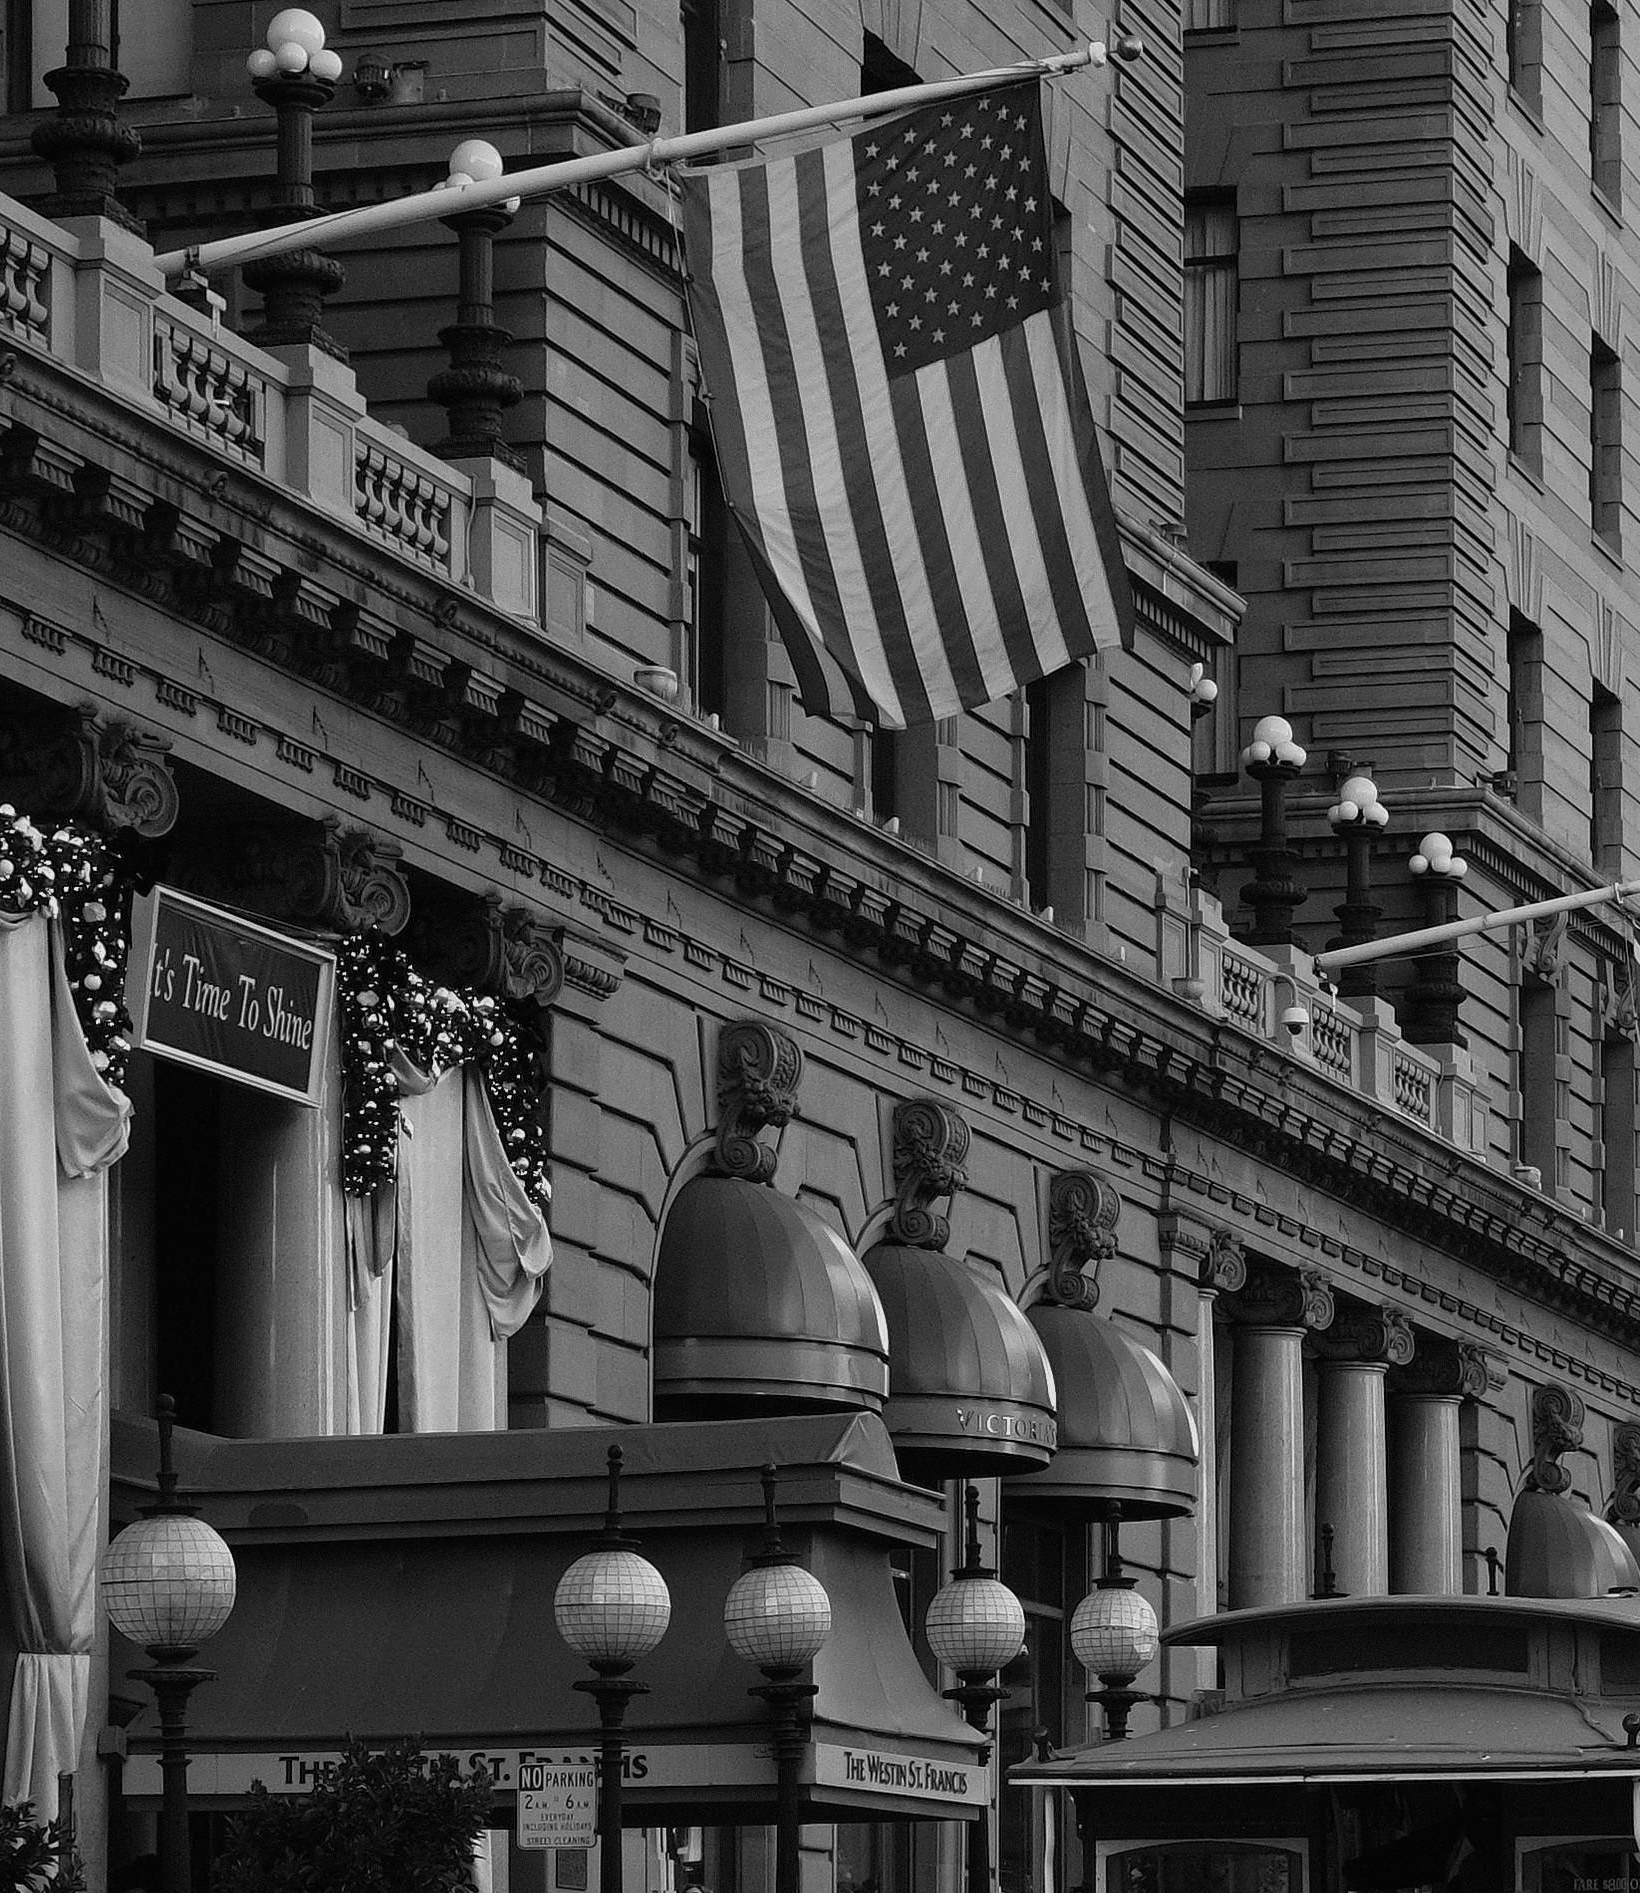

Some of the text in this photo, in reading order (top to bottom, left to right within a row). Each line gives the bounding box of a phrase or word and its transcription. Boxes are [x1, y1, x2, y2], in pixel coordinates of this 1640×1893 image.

[154, 948, 312, 1050] t's Time To Shine
[521, 1766, 542, 1789] NO
[545, 1771, 594, 1788] PARKING
[844, 1751, 865, 1781] THE
[867, 1754, 906, 1787] WESTIN
[925, 1762, 968, 1794] FRANCIS
[524, 1793, 534, 1810] 2
[565, 1793, 575, 1810] 6
[553, 1835, 591, 1846] CLEANING
